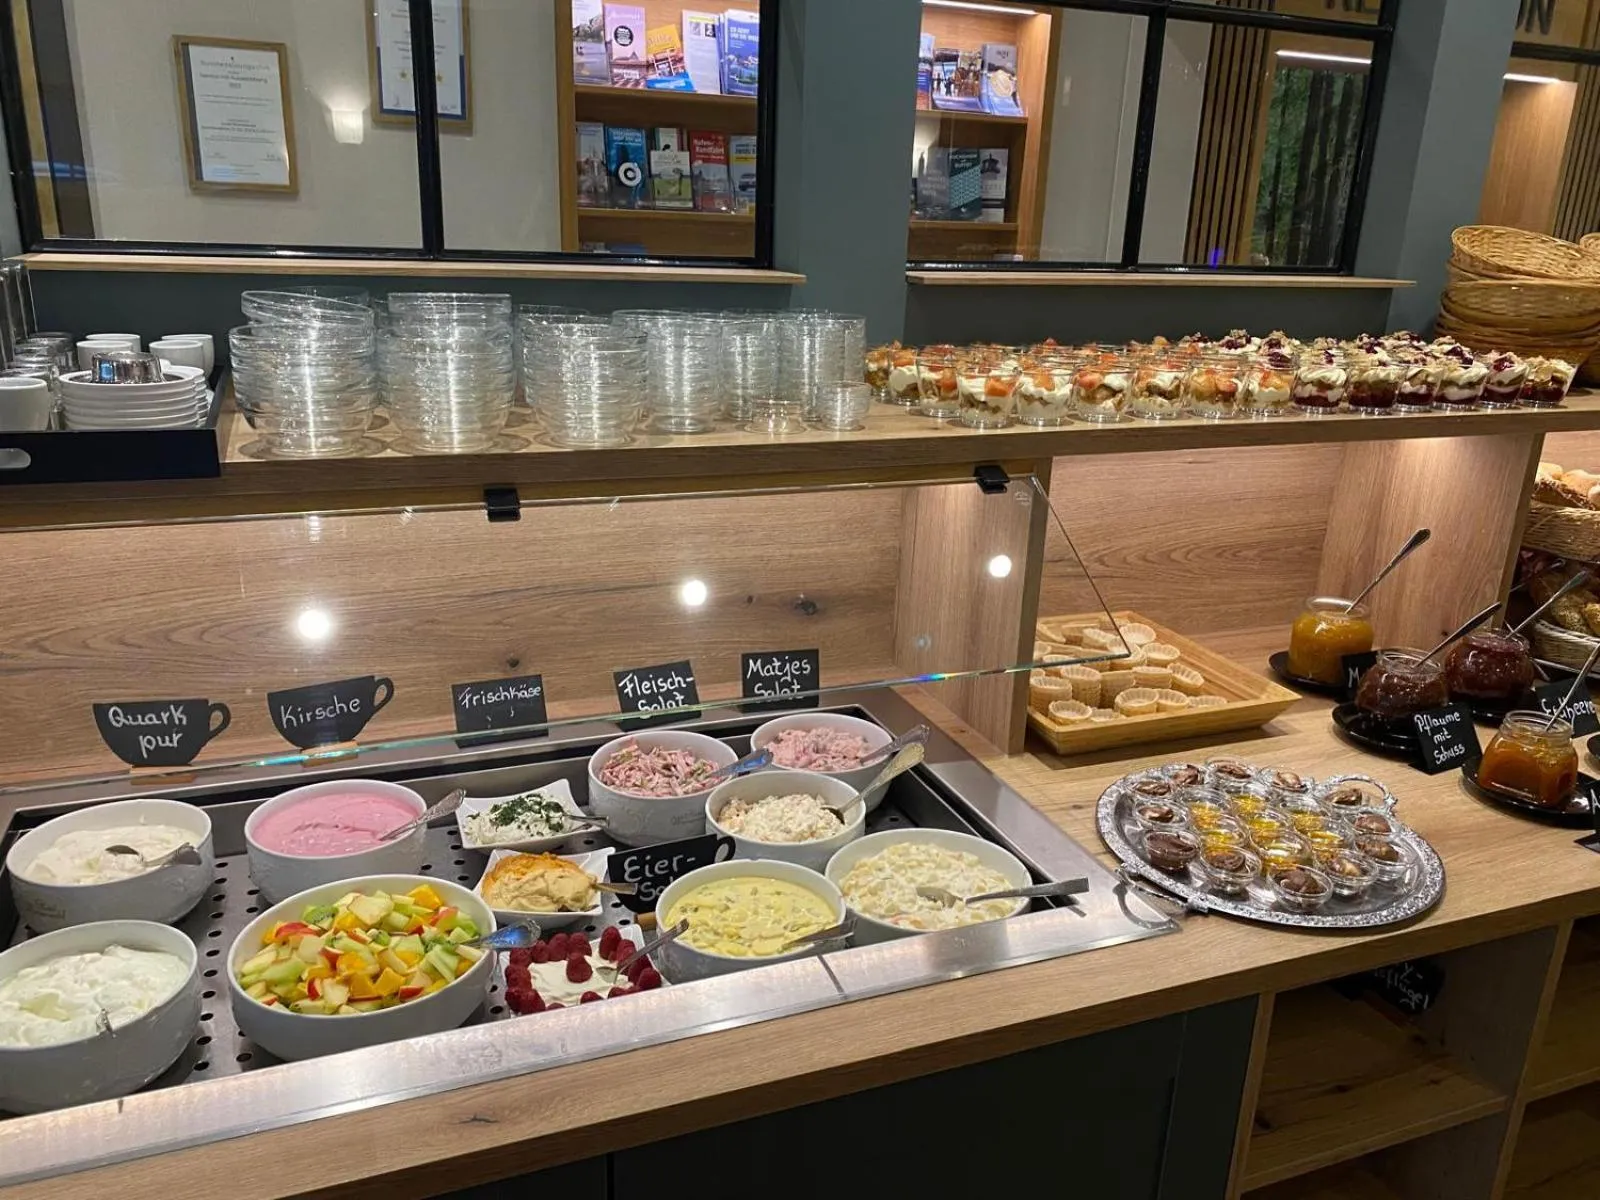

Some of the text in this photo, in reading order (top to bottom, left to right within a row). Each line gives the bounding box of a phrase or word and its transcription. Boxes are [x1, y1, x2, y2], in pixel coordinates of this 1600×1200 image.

[747, 656, 811, 682] Matjes
[457, 684, 542, 709] Frischkäse
[618, 671, 695, 698] Fleisch-
[754, 679, 804, 703] Salat
[108, 704, 188, 728] Quark
[281, 695, 361, 729] Kirsche
[637, 691, 689, 719] Salat
[1414, 710, 1462, 735] Pflaume
[138, 729, 184, 759] pur
[1432, 730, 1452, 743] mit
[1434, 744, 1466, 766] Schuss
[623, 854, 696, 883] Eier-
